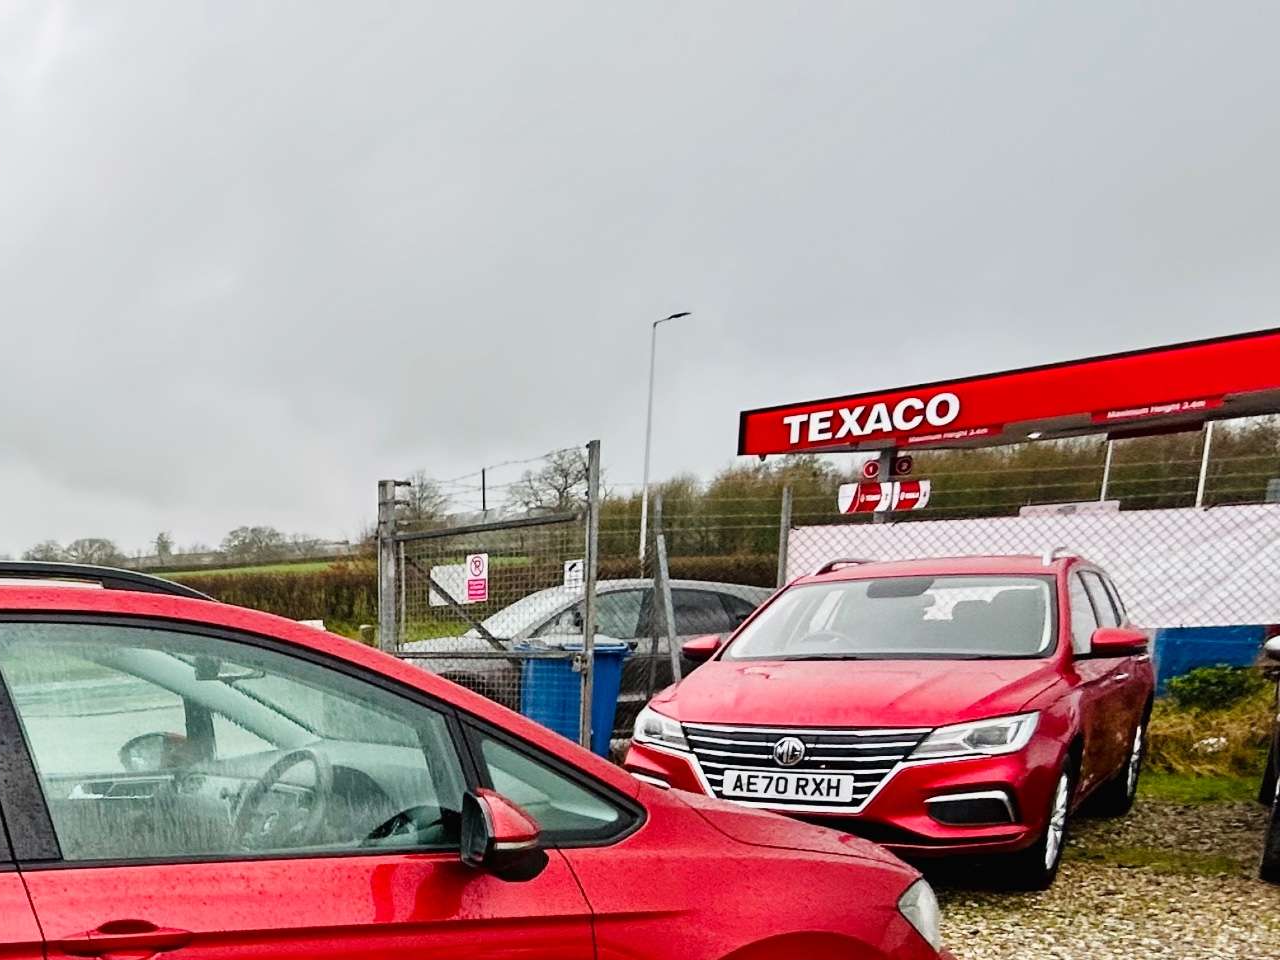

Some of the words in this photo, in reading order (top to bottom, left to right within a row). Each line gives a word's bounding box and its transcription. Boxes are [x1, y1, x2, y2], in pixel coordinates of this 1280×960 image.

[783, 392, 961, 444] TEXACO
[732, 774, 788, 794] AE70
[795, 777, 841, 797] RXH
